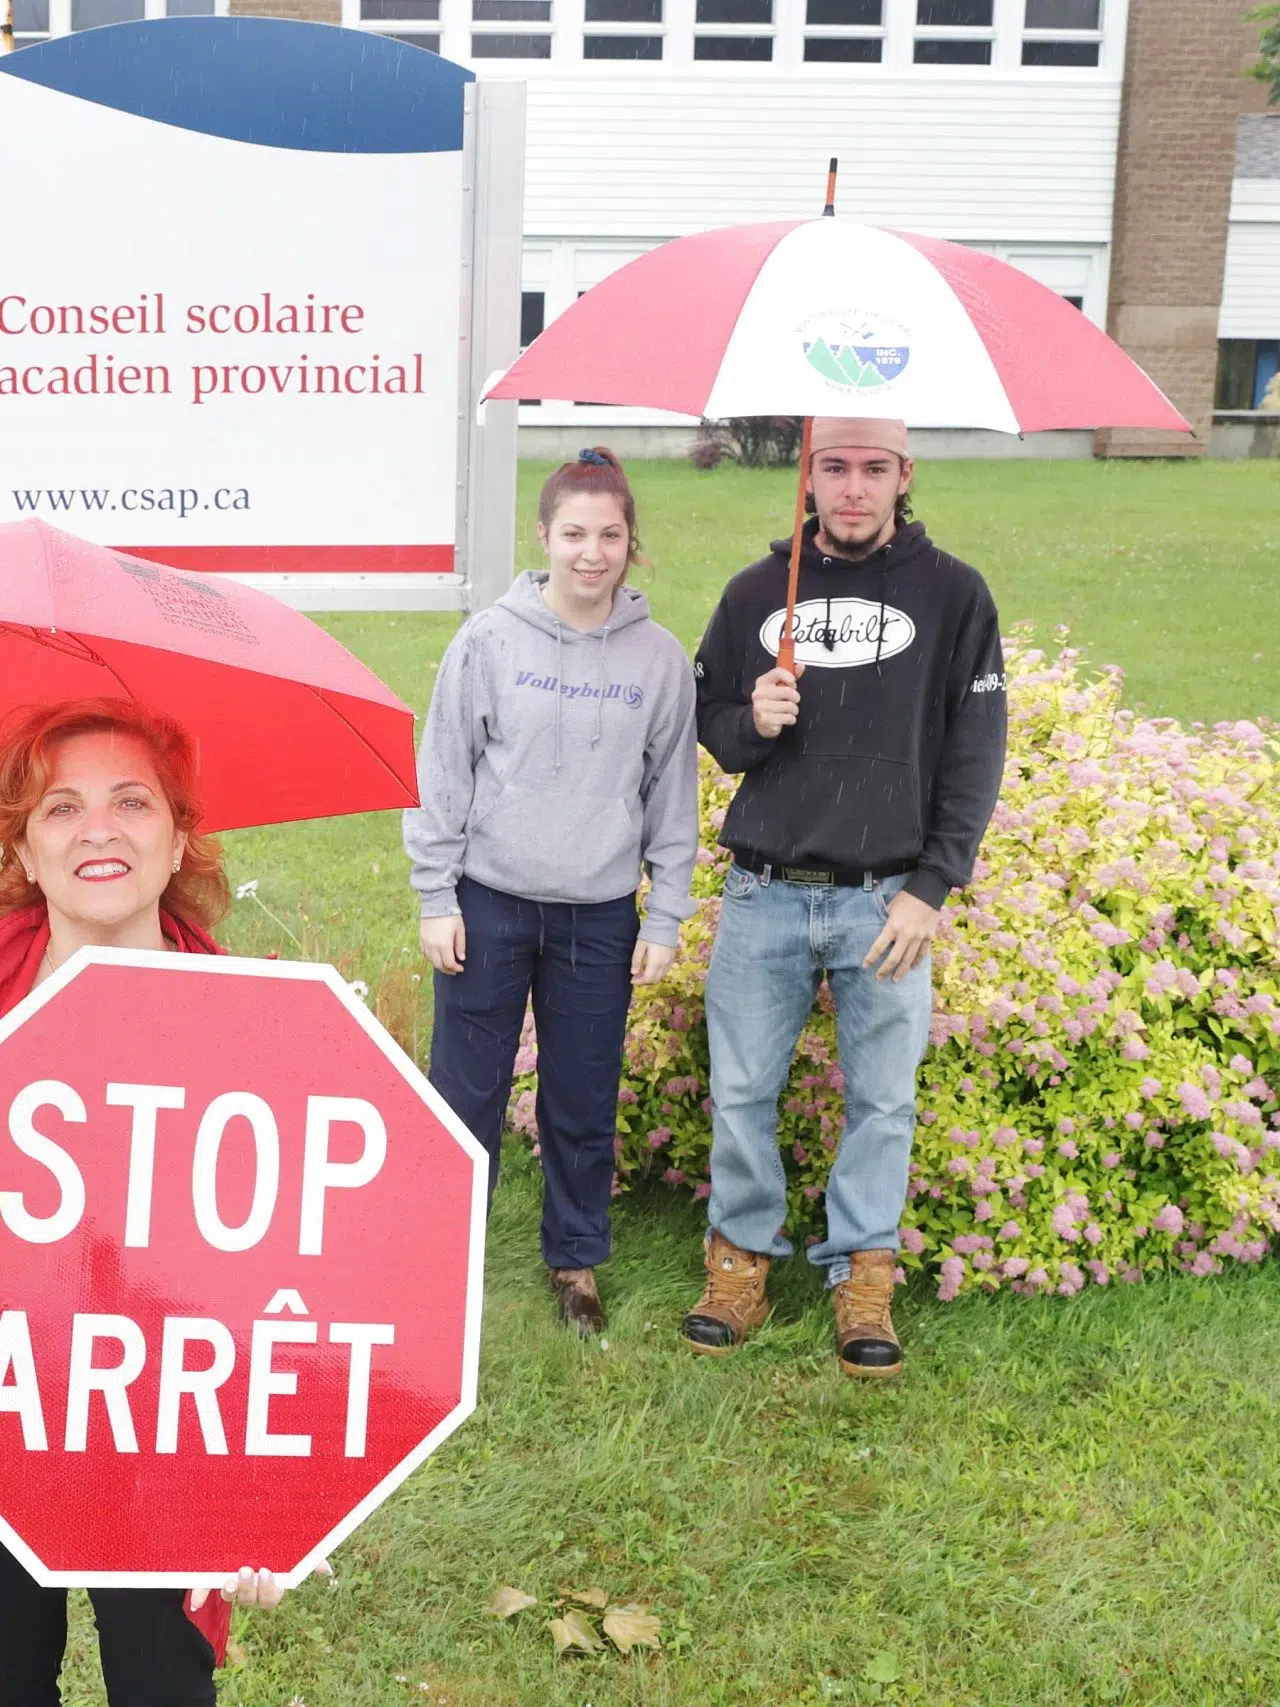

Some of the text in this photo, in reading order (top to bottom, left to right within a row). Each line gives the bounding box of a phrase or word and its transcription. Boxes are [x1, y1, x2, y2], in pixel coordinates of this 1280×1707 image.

[186, 293, 365, 334] scolaire
[191, 353, 425, 405] provincial
[12, 488, 251, 518] www.csap.ca
